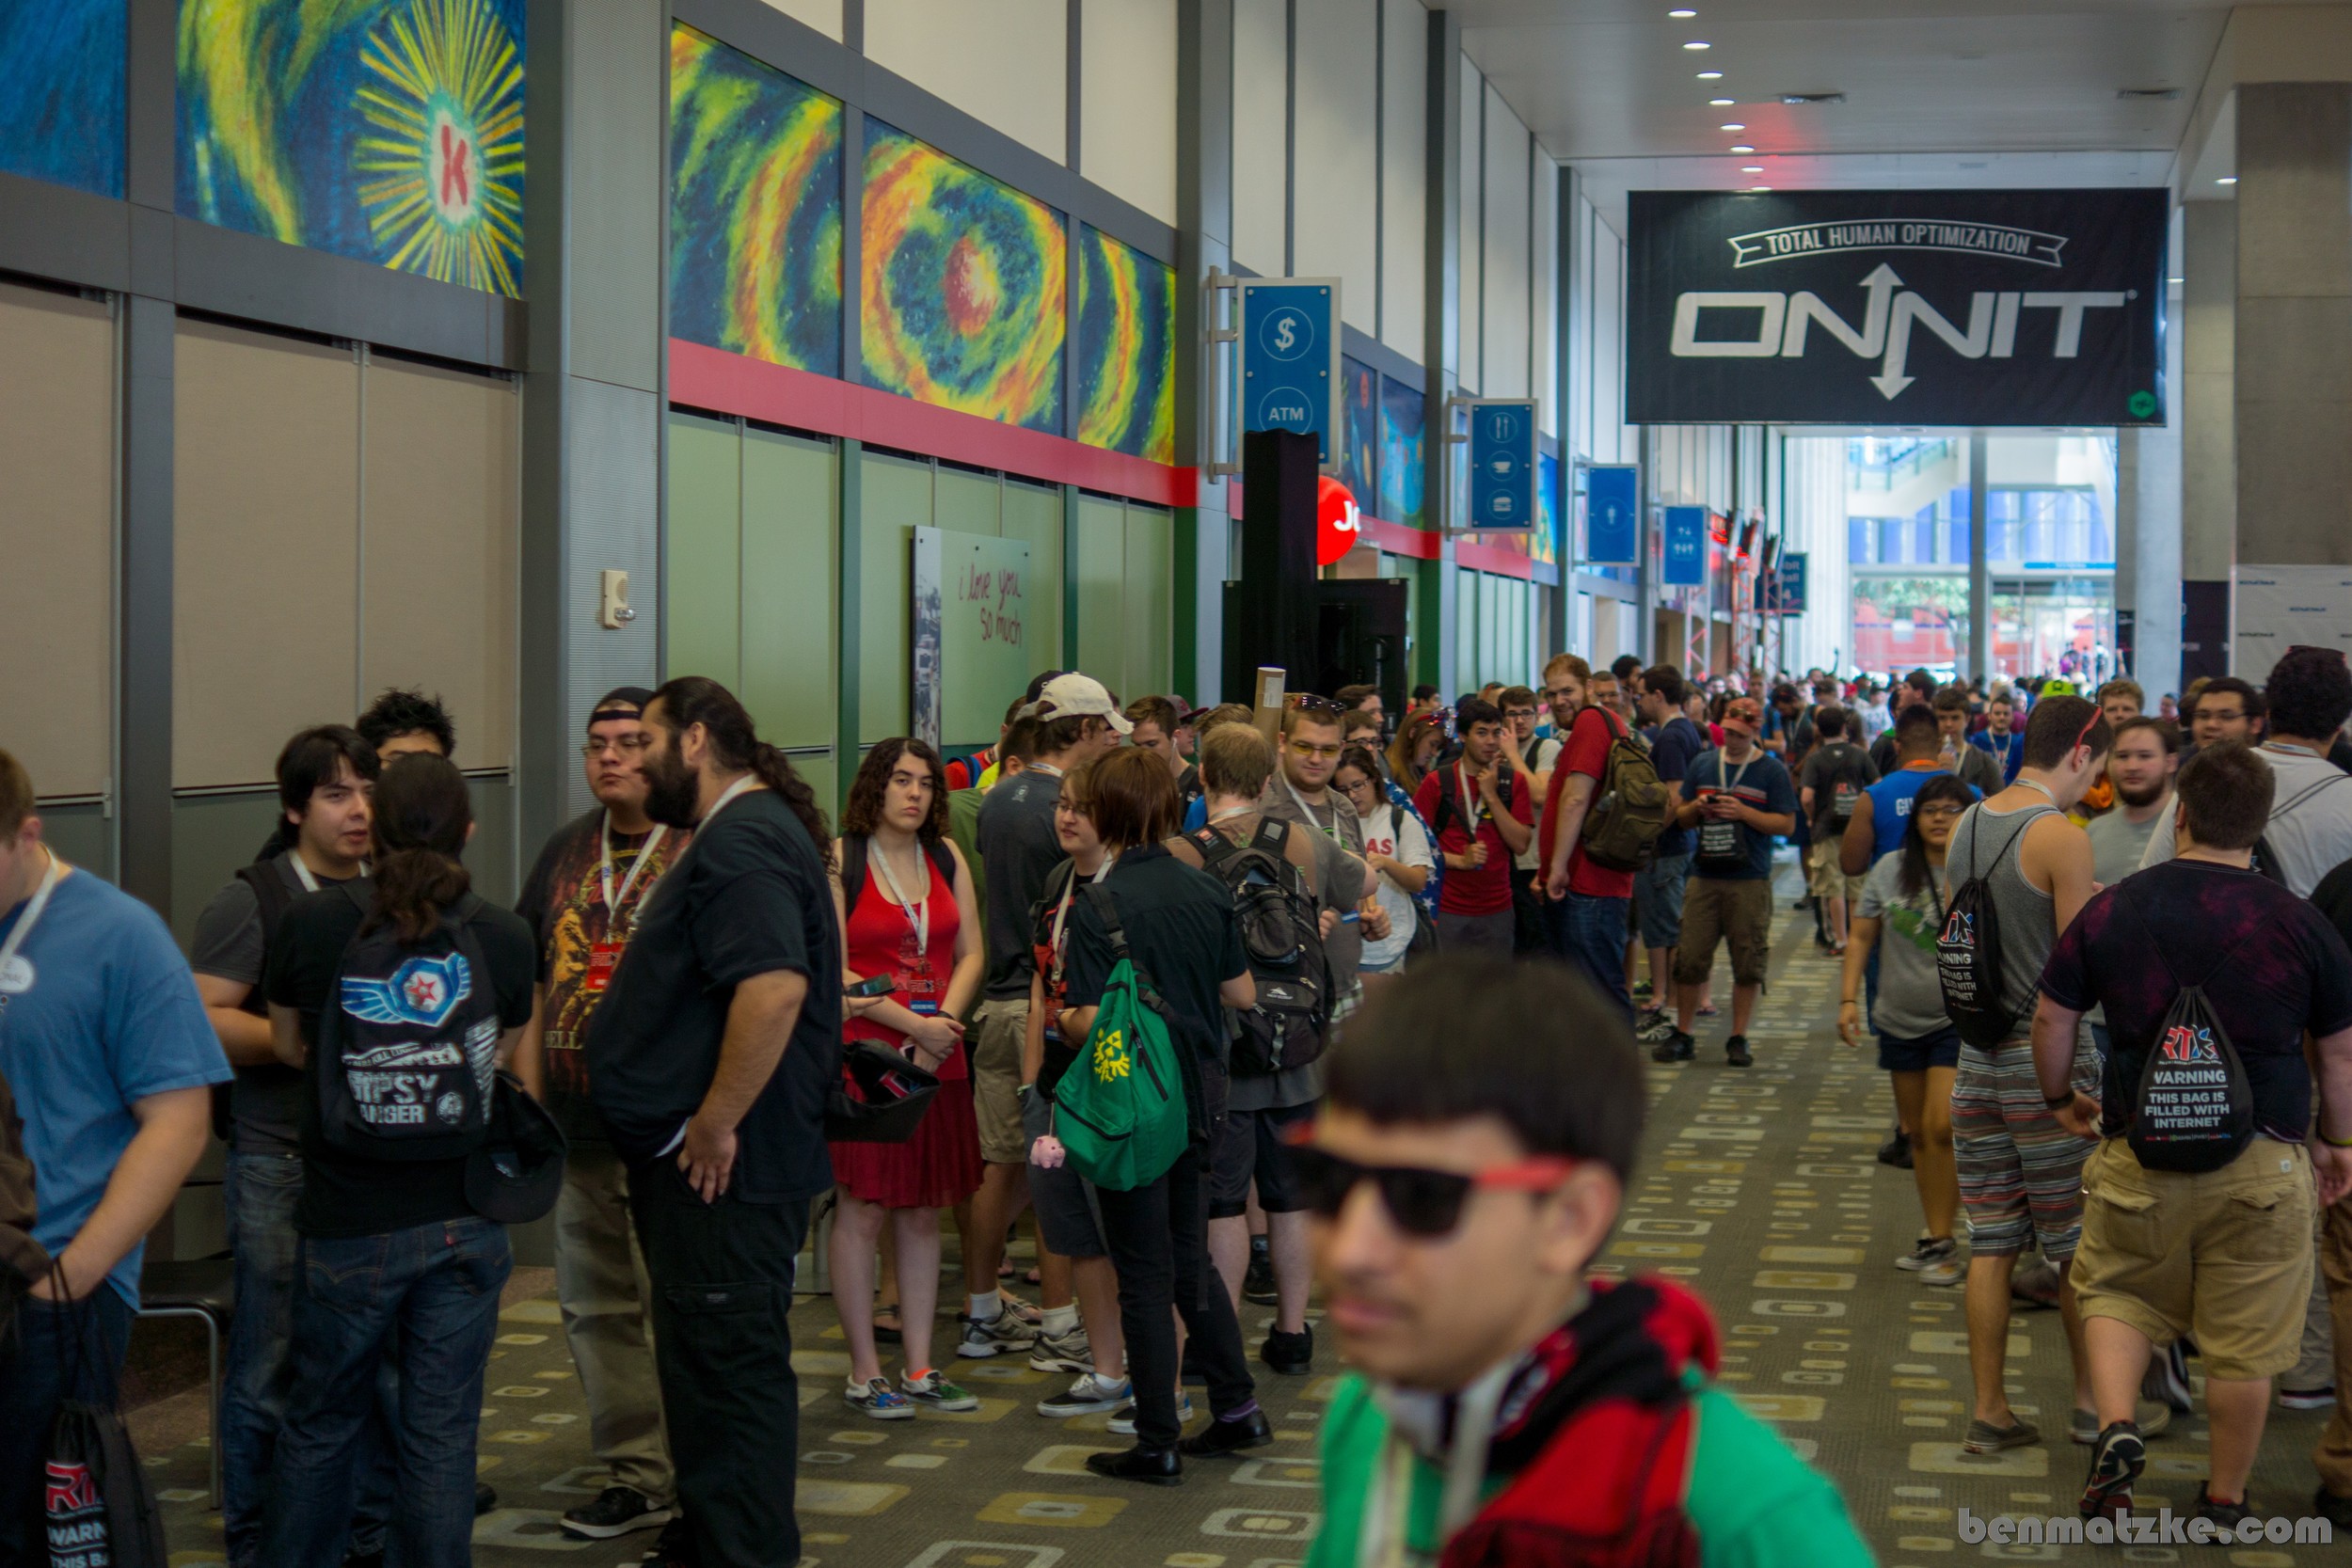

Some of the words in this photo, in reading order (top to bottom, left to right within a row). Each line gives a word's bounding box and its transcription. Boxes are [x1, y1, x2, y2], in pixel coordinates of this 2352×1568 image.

[1765, 231, 1825, 256] TOTAL
[1829, 224, 1898, 247] HUMAN
[1902, 223, 2032, 256] OPTIMIZATION
[1670, 284, 2126, 378] ONNIT
[1268, 407, 1304, 421] ATM
[967, 562, 992, 601] love
[995, 610, 1023, 651] much
[1366, 838, 1393, 856] AS
[2149, 1093, 2179, 1104] THIS
[2181, 1092, 2210, 1103] BAG
[2213, 1091, 2226, 1102] IS
[2145, 1105, 2190, 1117] FILLED
[2193, 1103, 2230, 1115] WITH
[2154, 1117, 2221, 1129] INTERNET
